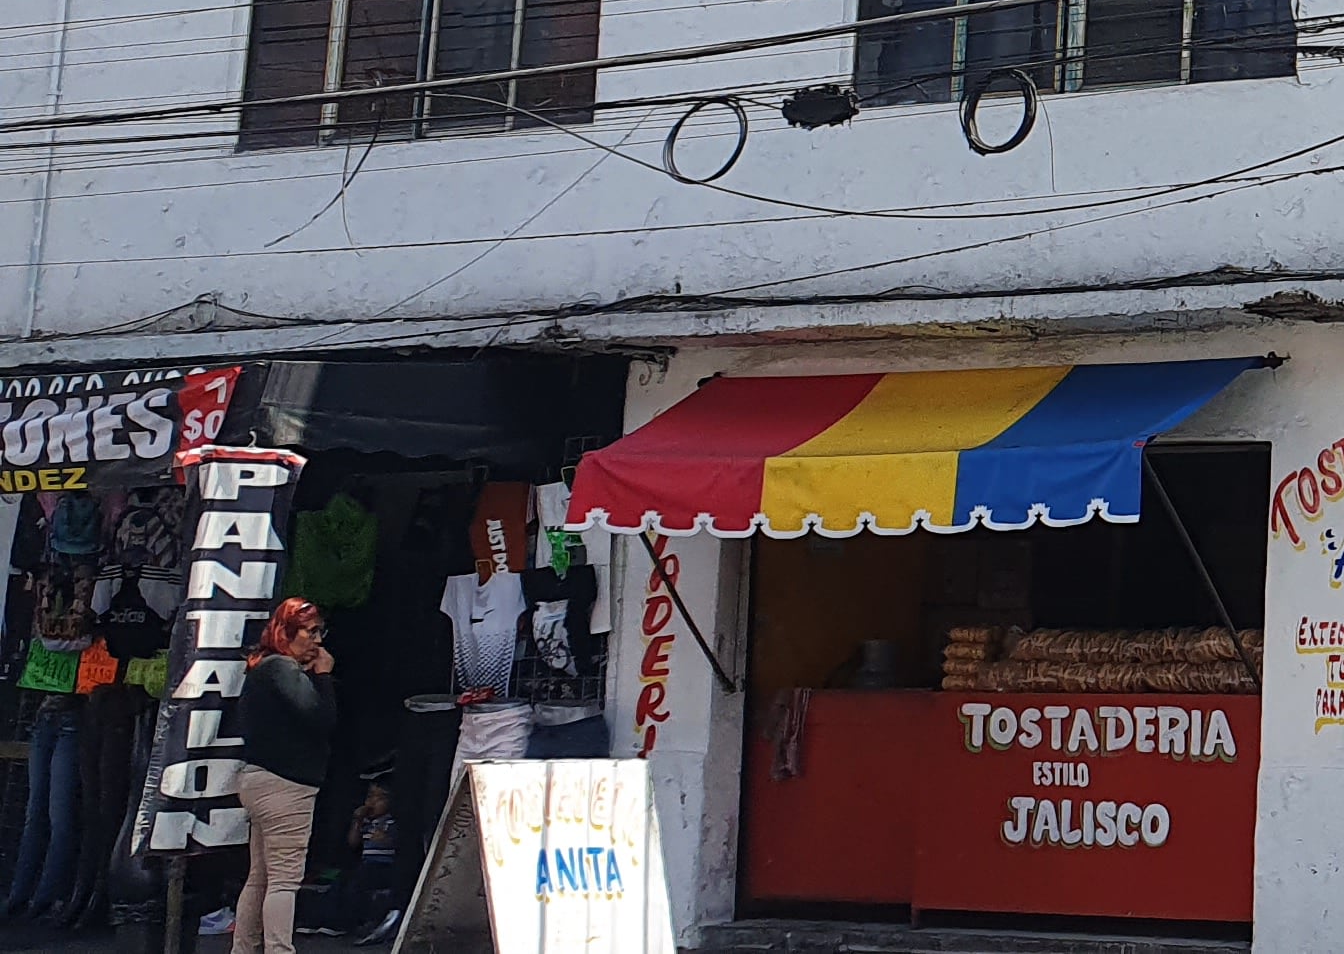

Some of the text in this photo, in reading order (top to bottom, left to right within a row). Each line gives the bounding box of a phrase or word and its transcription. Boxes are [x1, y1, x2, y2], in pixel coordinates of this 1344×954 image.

[0, 387, 174, 467] ONES
[150, 462, 290, 850] PANTALON
[960, 702, 1238, 757] TOSTADERIA
[1033, 761, 1089, 787] ESTILO
[1003, 796, 1171, 846] JALISCO
[536, 847, 624, 894] ANITA
